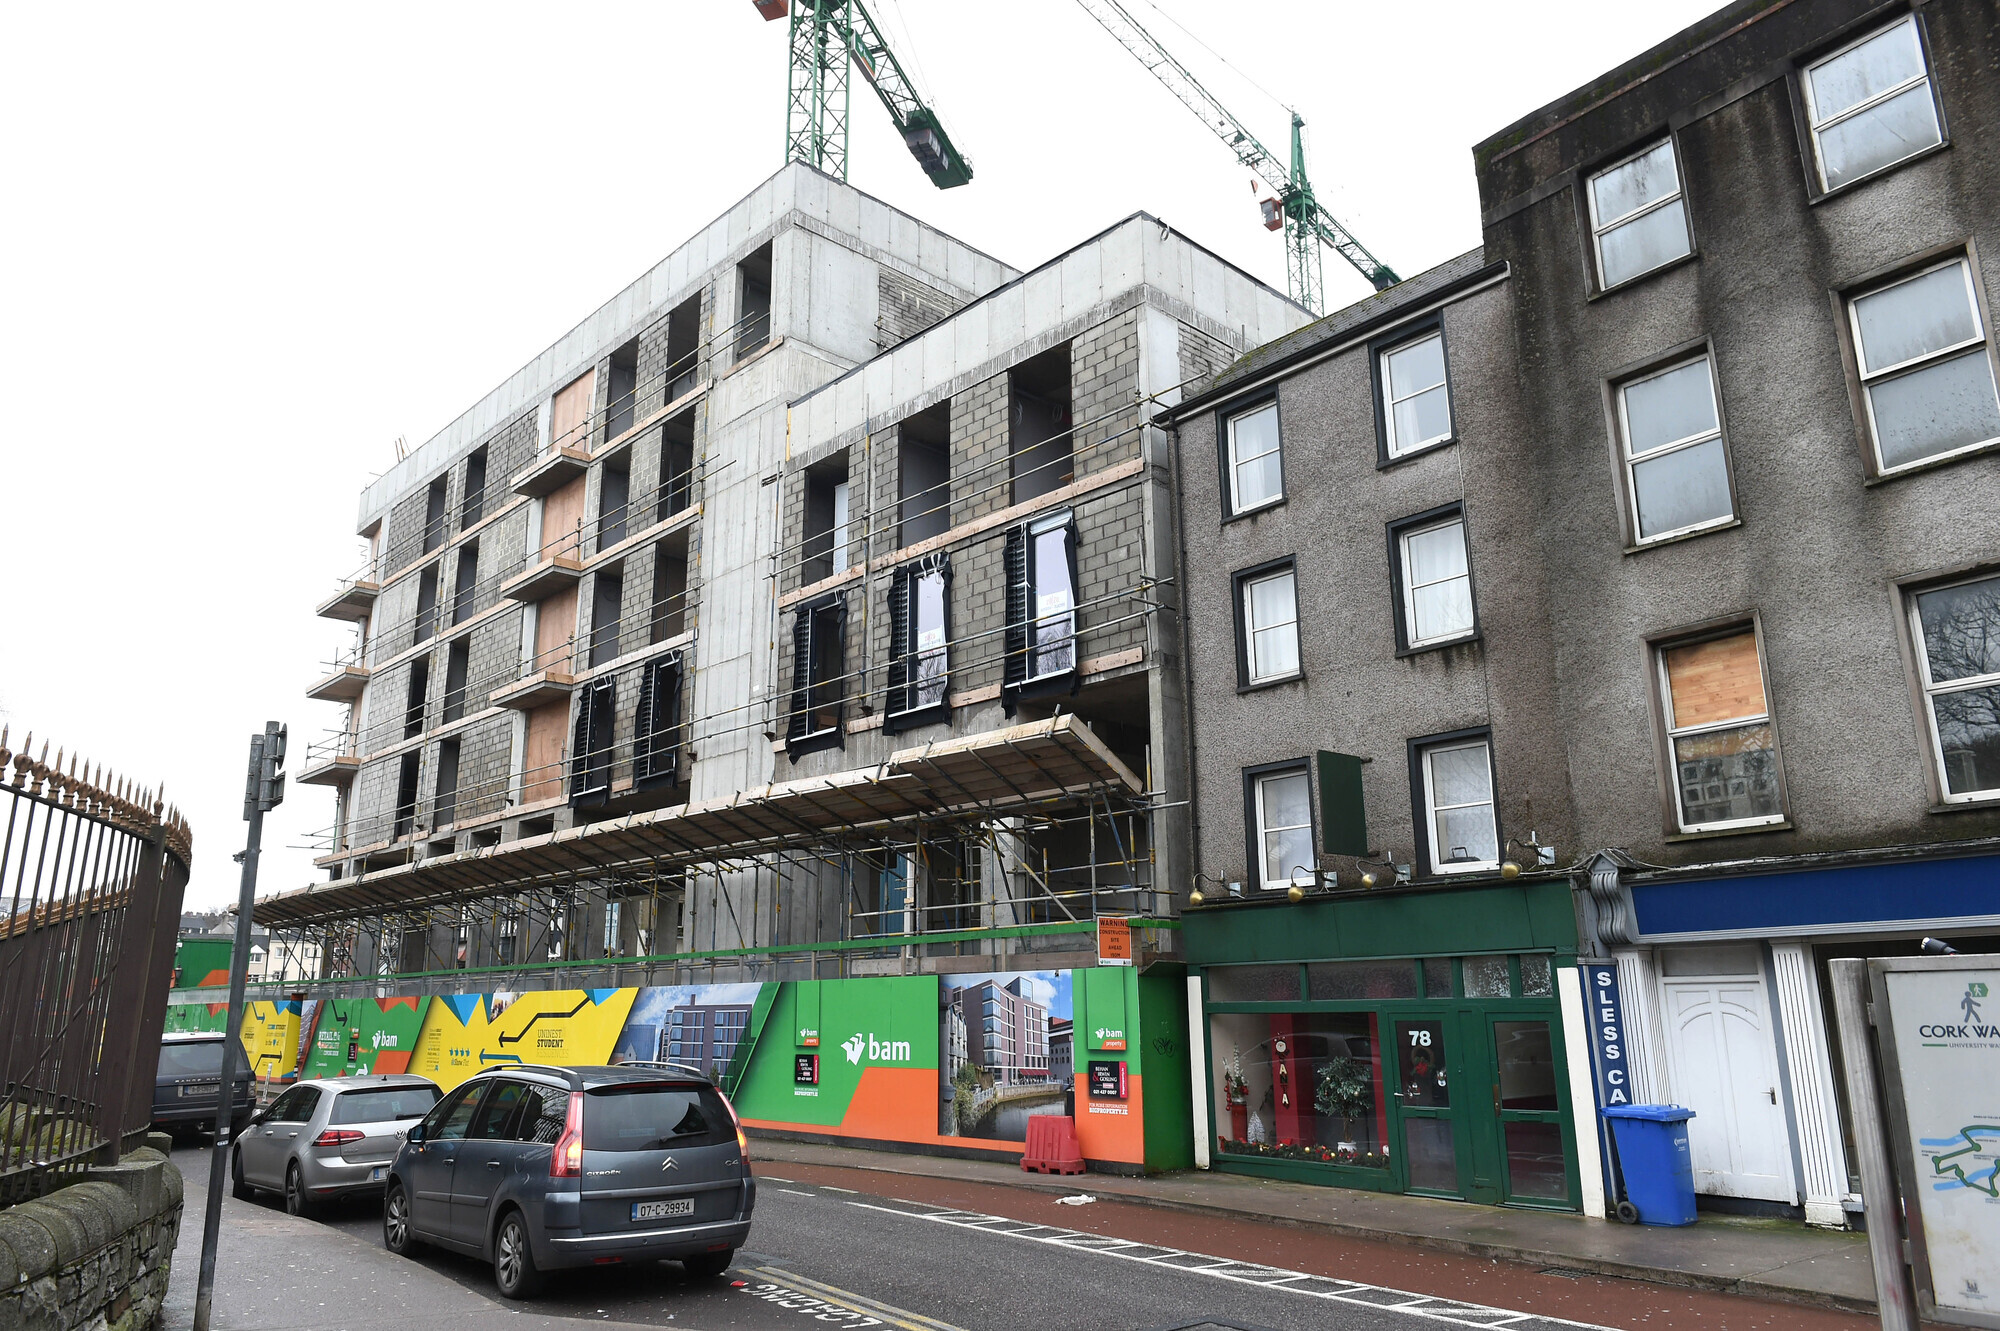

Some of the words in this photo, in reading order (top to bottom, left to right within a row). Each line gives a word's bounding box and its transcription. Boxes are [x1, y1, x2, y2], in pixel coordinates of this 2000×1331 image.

[381, 1030, 398, 1047] bam
[537, 1029, 562, 1039] UNINEST
[1106, 1028, 1123, 1038] bam
[1408, 1030, 1432, 1047] 78
[1919, 1025, 1969, 1038] CORK
[536, 1039, 564, 1048] STUDENT
[868, 1033, 911, 1061] bam
[1105, 1040, 1122, 1048] property
[640, 1201, 690, 1217] 07-C-29934
[739, 1284, 884, 1329] LOADING
